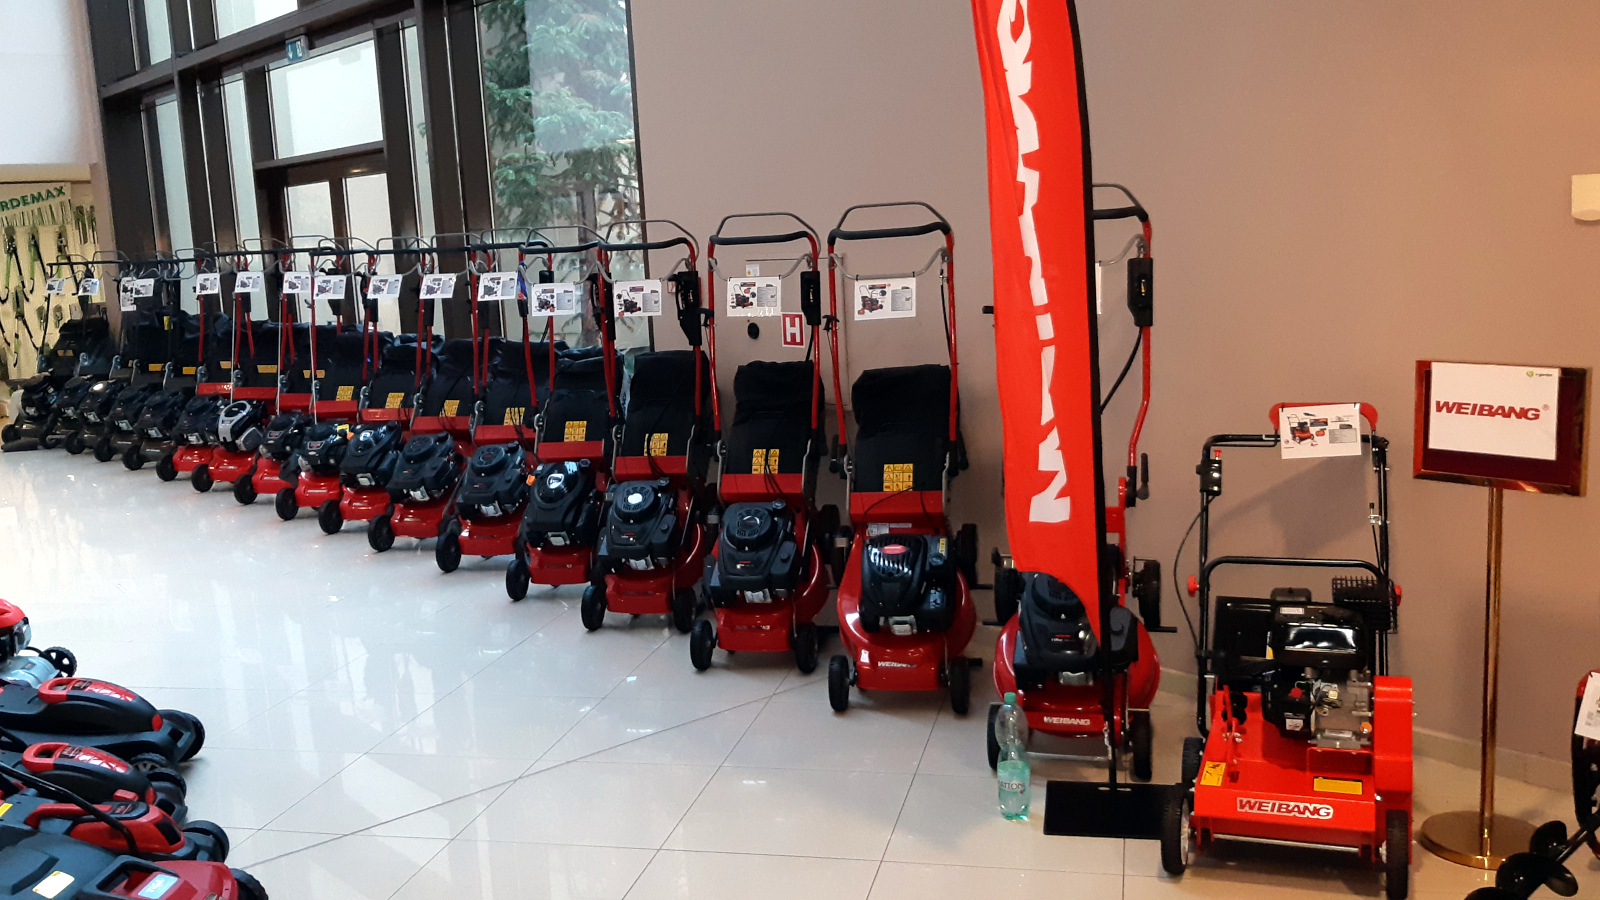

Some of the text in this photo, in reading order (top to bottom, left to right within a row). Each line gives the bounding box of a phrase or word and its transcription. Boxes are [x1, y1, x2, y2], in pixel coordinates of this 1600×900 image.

[0, 185, 66, 212] RDEMAX
[785, 316, 801, 343] H
[1435, 400, 1541, 421] WEIBANG
[1043, 716, 1091, 726] WEIBANG
[1237, 798, 1333, 819] WEIBANG
